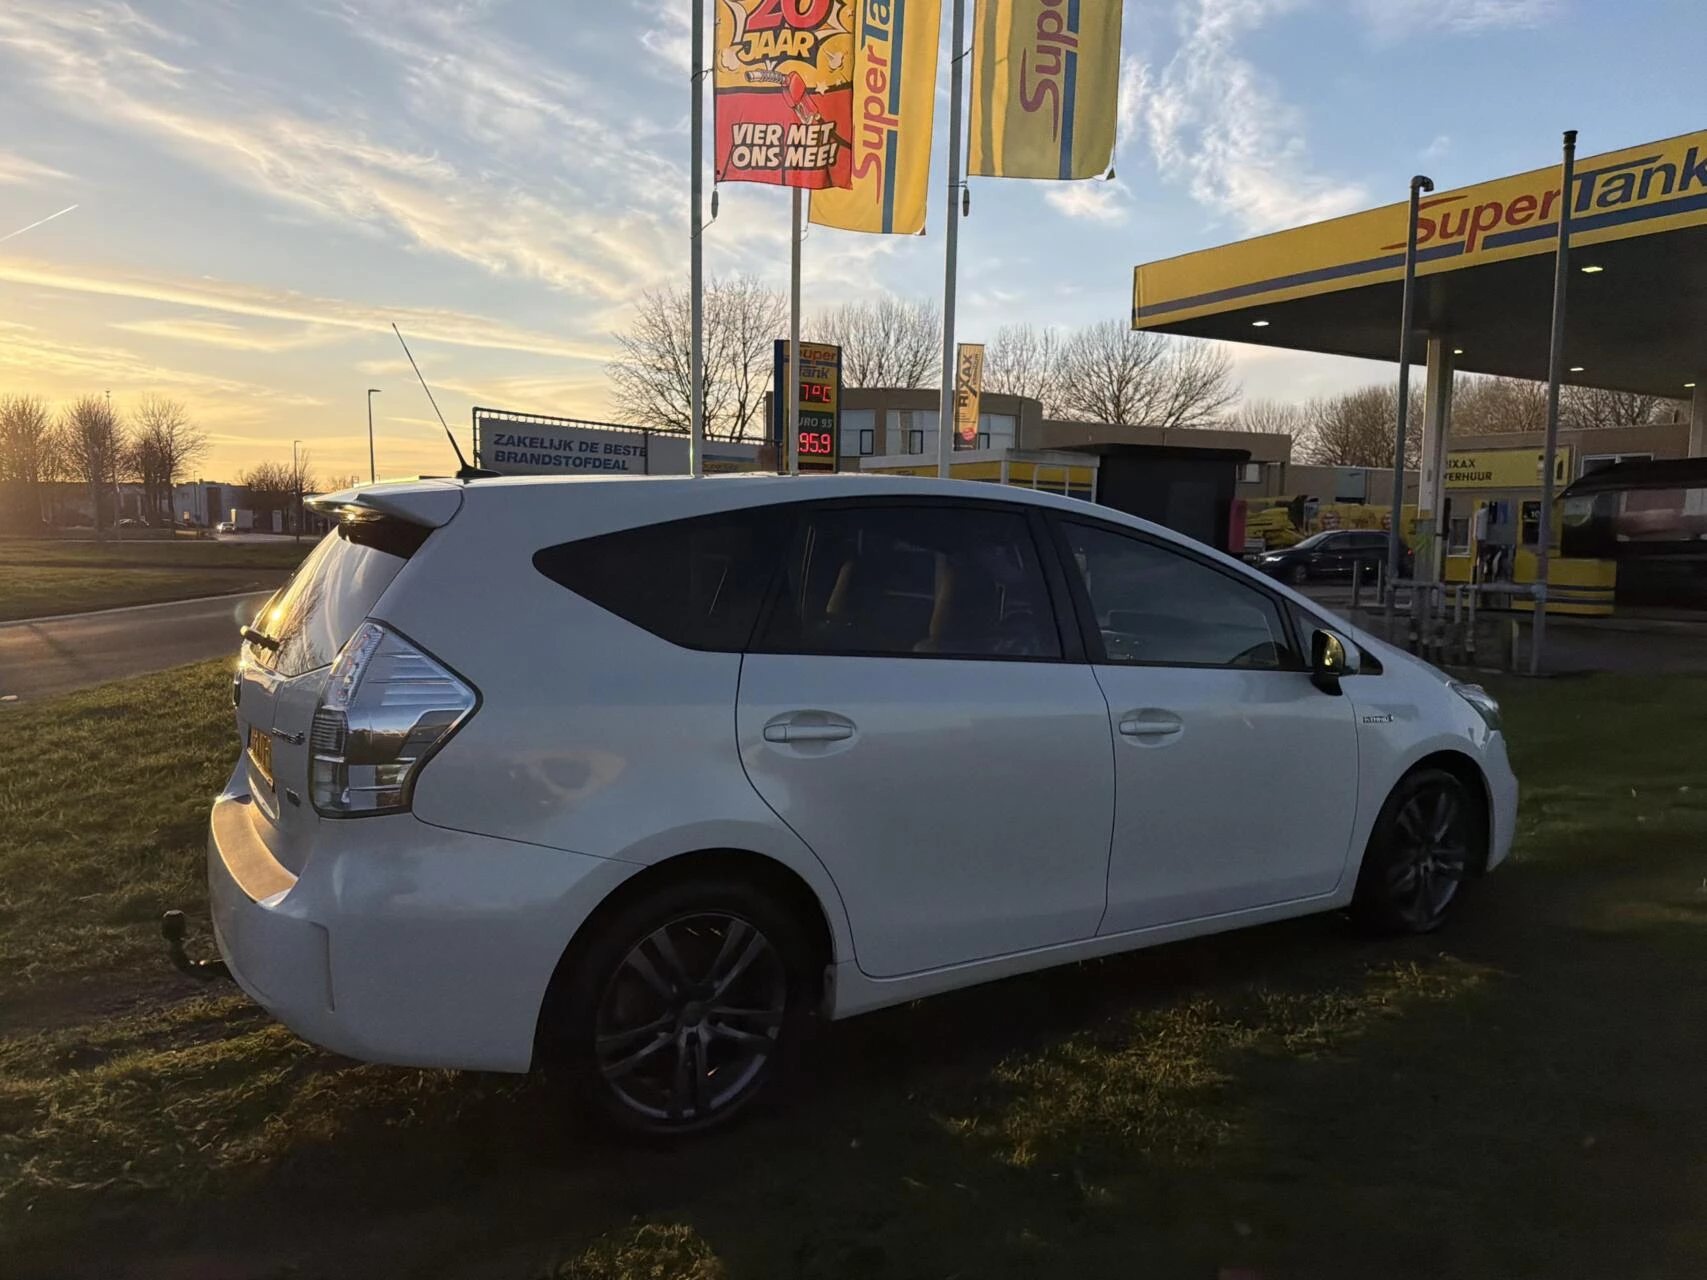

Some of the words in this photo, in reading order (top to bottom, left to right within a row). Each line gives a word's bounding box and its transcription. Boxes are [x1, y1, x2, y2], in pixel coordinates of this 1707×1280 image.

[737, 29, 815, 62] JAAR
[1019, 0, 1079, 143] Sup
[732, 123, 783, 146] VIER
[787, 122, 835, 146] MET
[732, 146, 782, 168] ONS
[785, 143, 840, 168] MEE!
[799, 346, 836, 367] uper
[958, 354, 978, 408] RIXAX
[494, 433, 574, 452] ZAKELIJK
[578, 441, 600, 453] DE
[603, 443, 647, 457] BESTE
[494, 450, 629, 471] BRANDSTOFDEAL
[1447, 458, 1476, 469] IXAX
